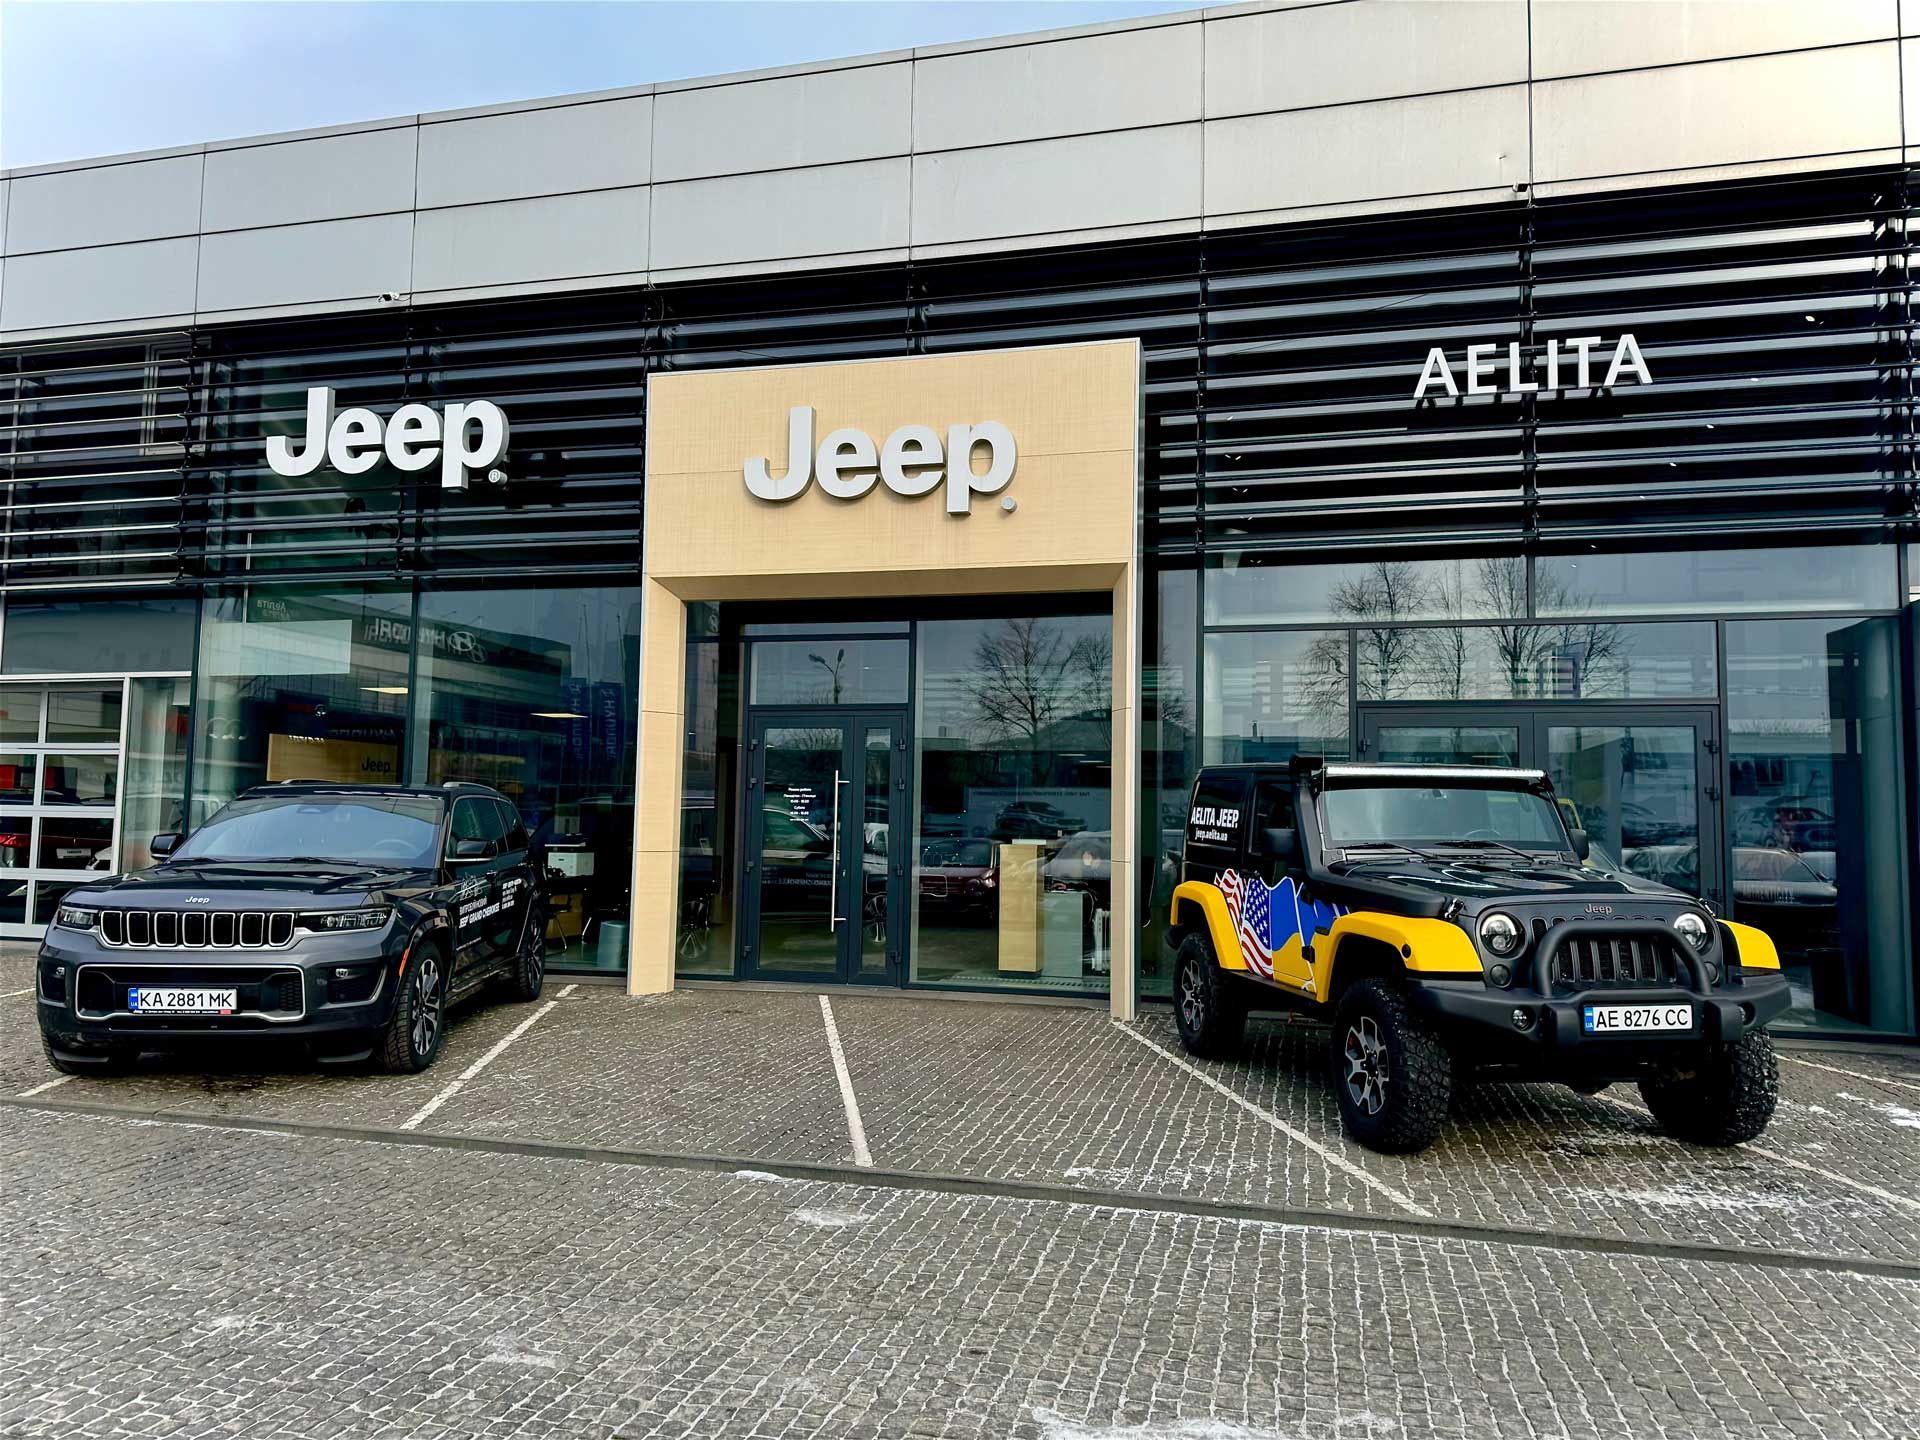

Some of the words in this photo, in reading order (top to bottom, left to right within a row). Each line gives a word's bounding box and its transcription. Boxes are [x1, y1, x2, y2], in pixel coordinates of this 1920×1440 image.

[1413, 334, 1653, 398] AELITA
[266, 386, 509, 489] Jeep
[744, 406, 1017, 515] Jeep
[361, 757, 392, 773] Jeep
[1190, 807, 1216, 826] AELITA
[1195, 827, 1228, 841] jeep.aelita.ua
[185, 896, 210, 904] Jeep
[1585, 903, 1613, 915] Jeep
[140, 992, 163, 1007] KA
[167, 992, 204, 1007] 2881
[209, 992, 232, 1007] MK
[1596, 1010, 1619, 1028] AE
[1624, 1009, 1660, 1027] 8276
[1665, 1009, 1688, 1026] CC
